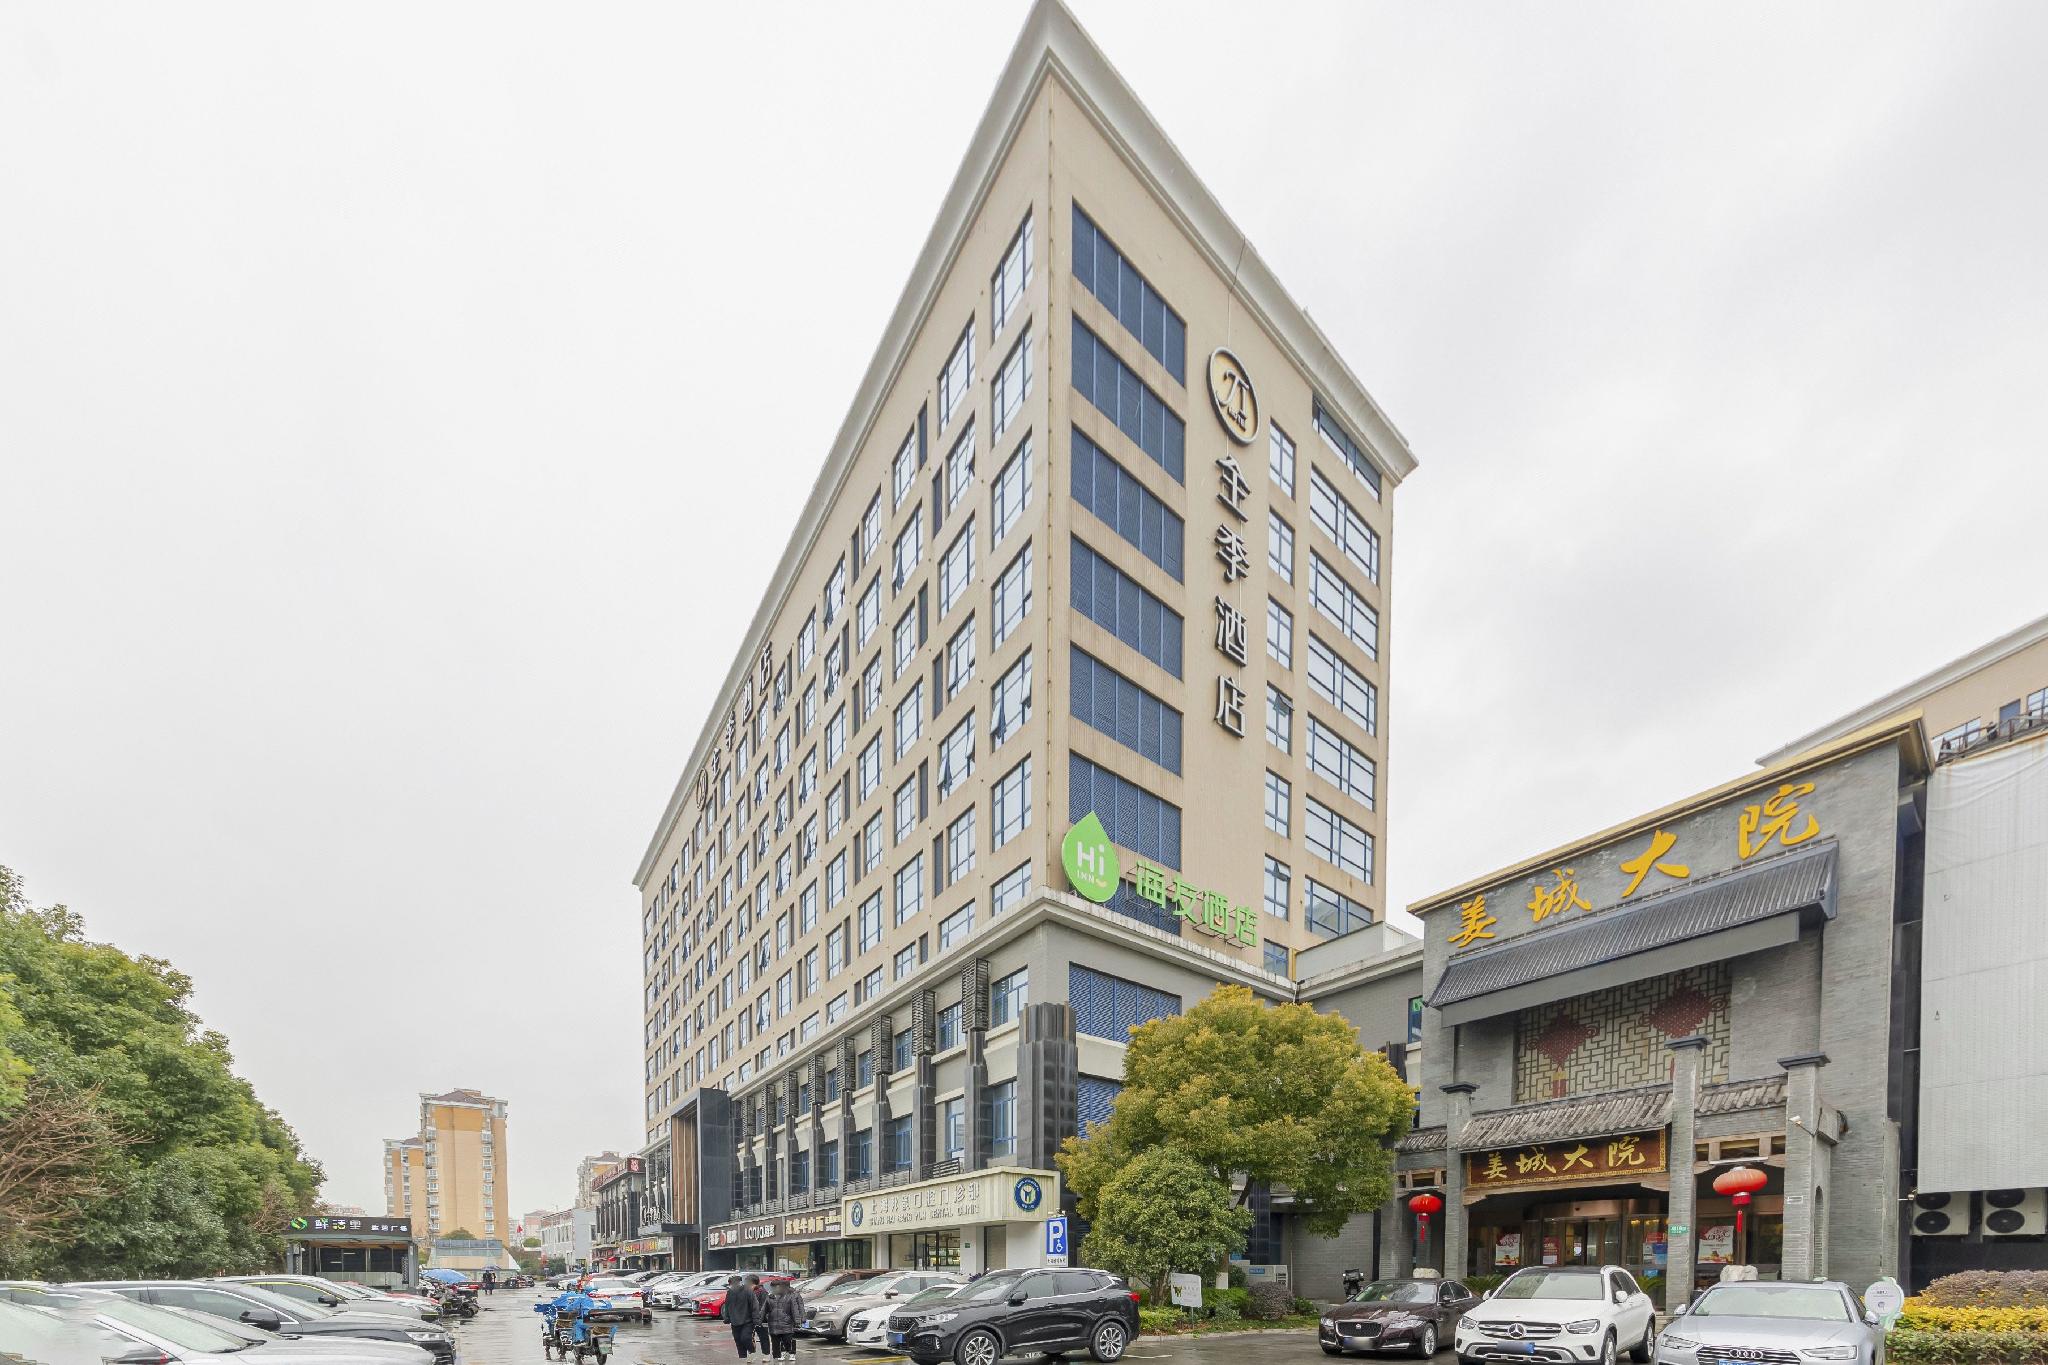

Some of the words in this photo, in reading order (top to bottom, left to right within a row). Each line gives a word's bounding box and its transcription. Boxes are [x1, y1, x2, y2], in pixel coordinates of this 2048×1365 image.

[1215, 454, 1250, 739] 全季酒店
[1077, 840, 1104, 876] Hi
[1447, 782, 1821, 948] 姜城大院
[1136, 860, 1257, 947] 海友酒店
[1482, 1135, 1646, 1179] 姜城大院
[1049, 1221, 1064, 1252] P
